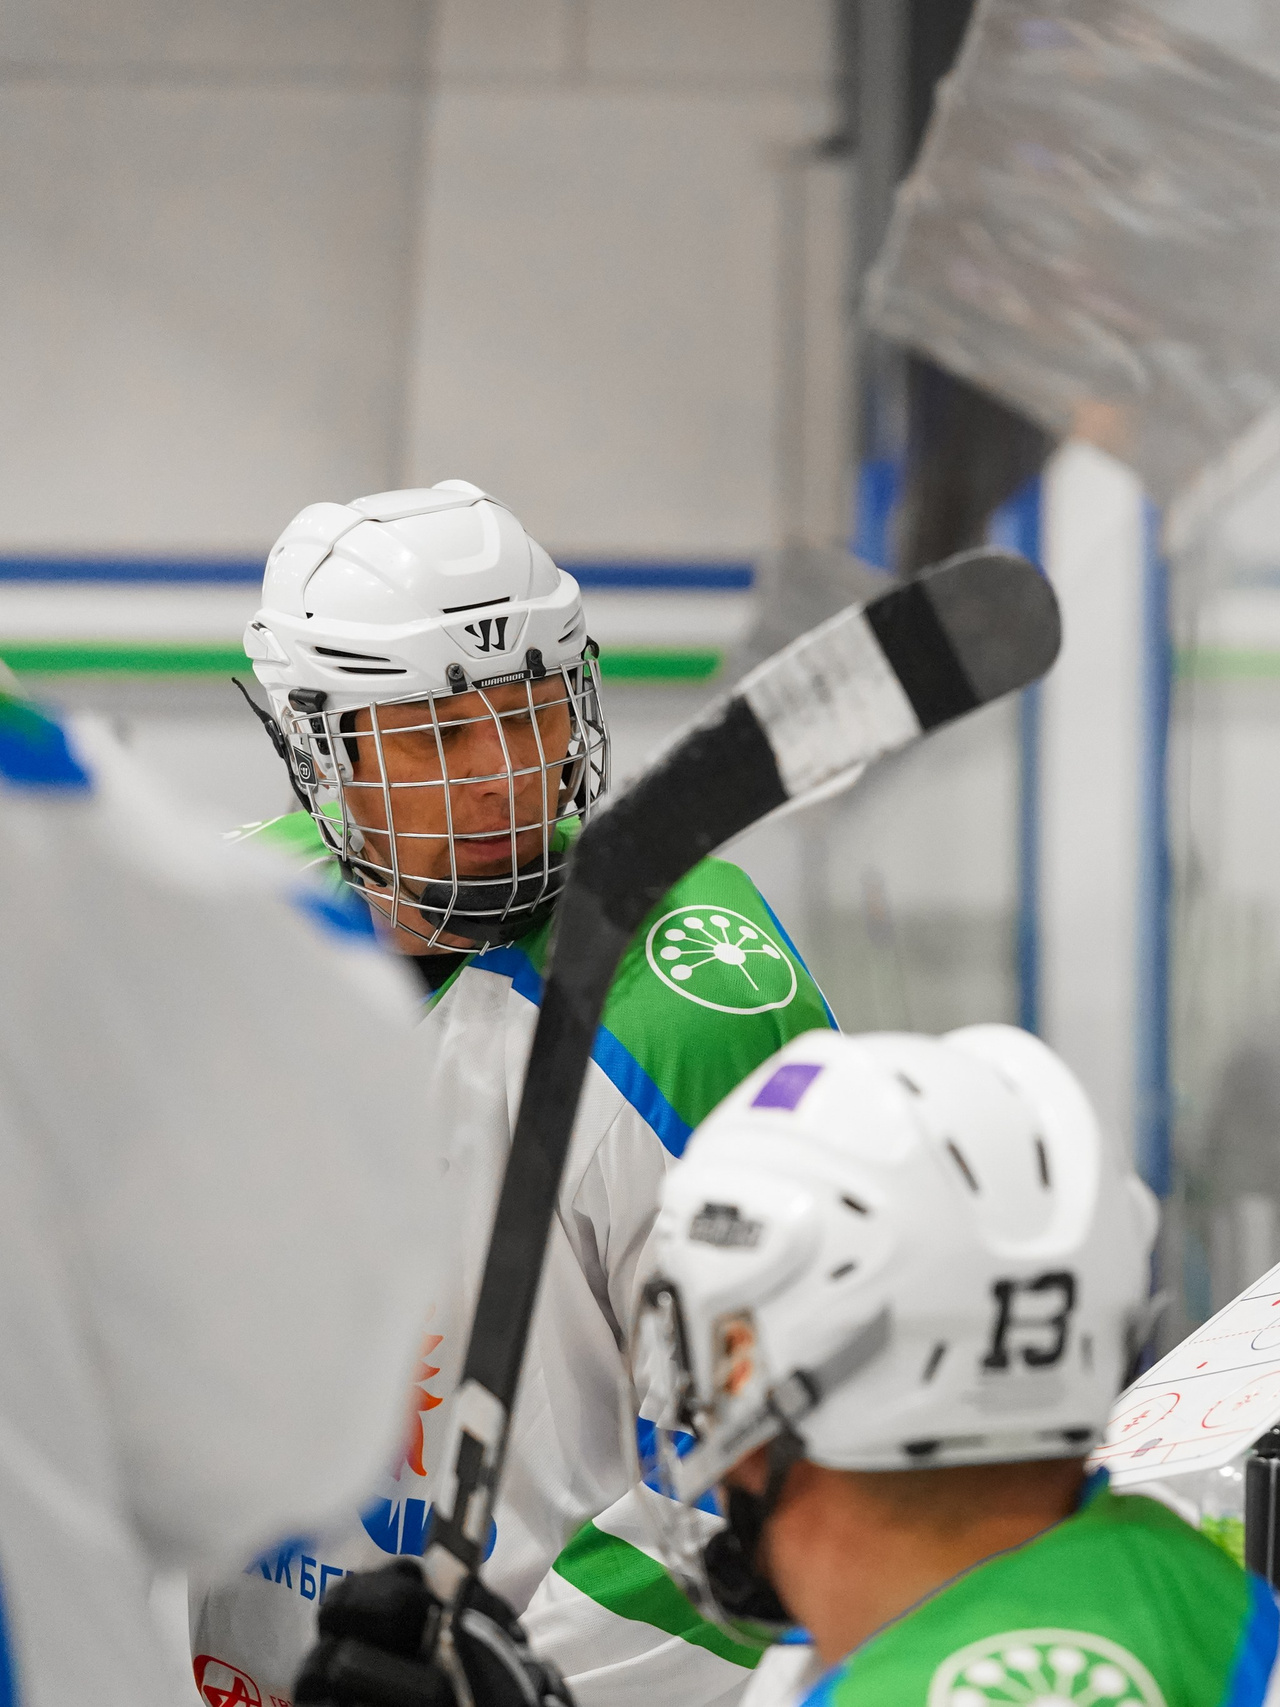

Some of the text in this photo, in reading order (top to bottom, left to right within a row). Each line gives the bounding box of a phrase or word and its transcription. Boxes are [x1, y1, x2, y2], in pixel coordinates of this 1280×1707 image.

[481, 673, 525, 688] WARRIOR
[980, 1269, 1079, 1371] 13
[300, 1554, 354, 1606] БГ
